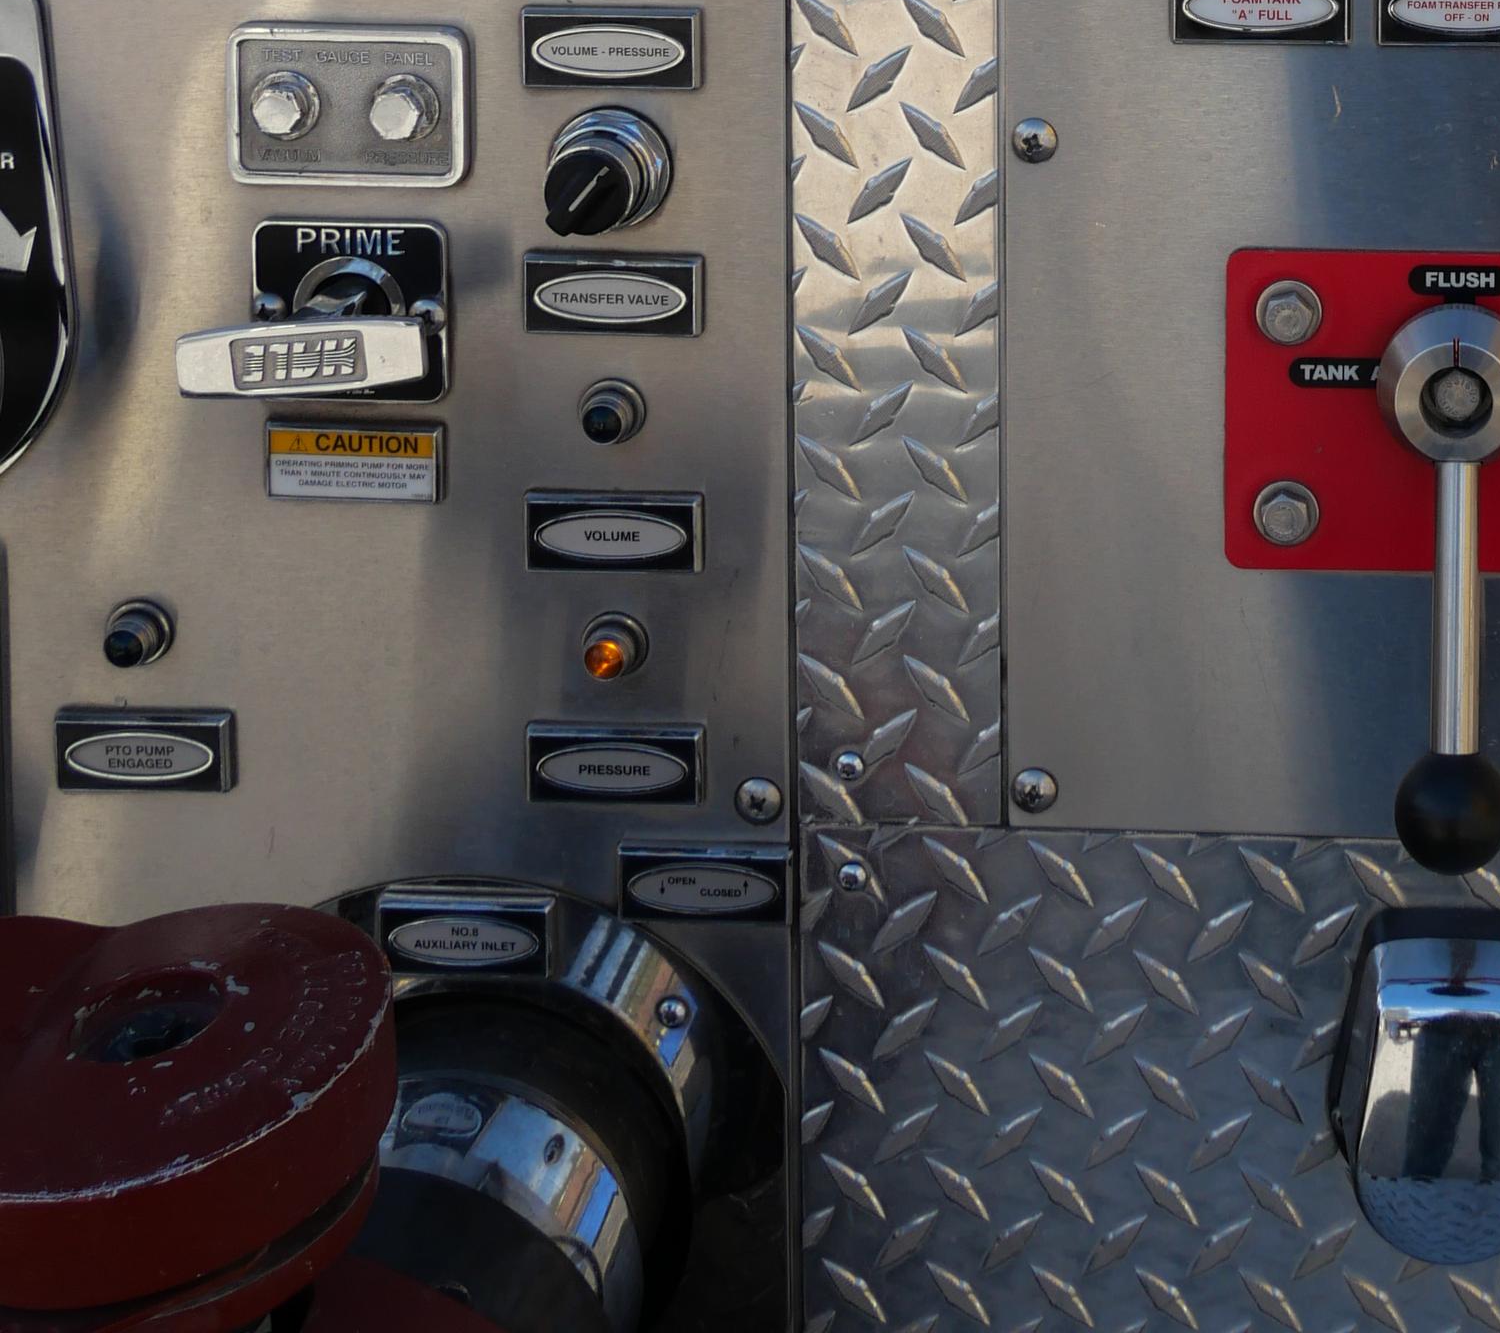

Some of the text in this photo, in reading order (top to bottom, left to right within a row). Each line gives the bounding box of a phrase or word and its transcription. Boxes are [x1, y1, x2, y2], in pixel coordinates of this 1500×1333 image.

[1407, 1, 1436, 10] FOAM
[1438, 1, 1494, 10] TRANSFER
[1232, 9, 1292, 21] "A" FULL
[1444, 13, 1465, 22] OFF
[1474, 13, 1490, 22] ON
[262, 49, 433, 66] TEST GAUGE PANEL
[551, 46, 598, 56] VOLUME
[608, 47, 670, 58] PRESSURE
[296, 228, 406, 256] PRIME
[1425, 271, 1496, 289] FLUSH
[552, 292, 669, 306] TRANSFER VALVE
[1299, 364, 1359, 381] TANK
[315, 434, 418, 454] CAUTION
[275, 459, 322, 468] OPERATING
[324, 461, 359, 469] PRIMING
[361, 461, 385, 469] PUMP
[406, 463, 430, 471] MORE
[310, 470, 341, 478] MINUTE
[344, 471, 407, 480] CONTINUOUSLY
[298, 479, 333, 487] DAMAGE
[336, 480, 376, 489] ELECTRIC
[584, 530, 640, 542] VOLUME
[105, 745, 175, 757] PTO PUMP
[108, 758, 173, 769] ENGAGED
[578, 764, 651, 776] PRESSURE
[667, 876, 696, 885] OPEN
[700, 888, 742, 898] CLOSED
[414, 939, 517, 952] AUXILIARY INLET
